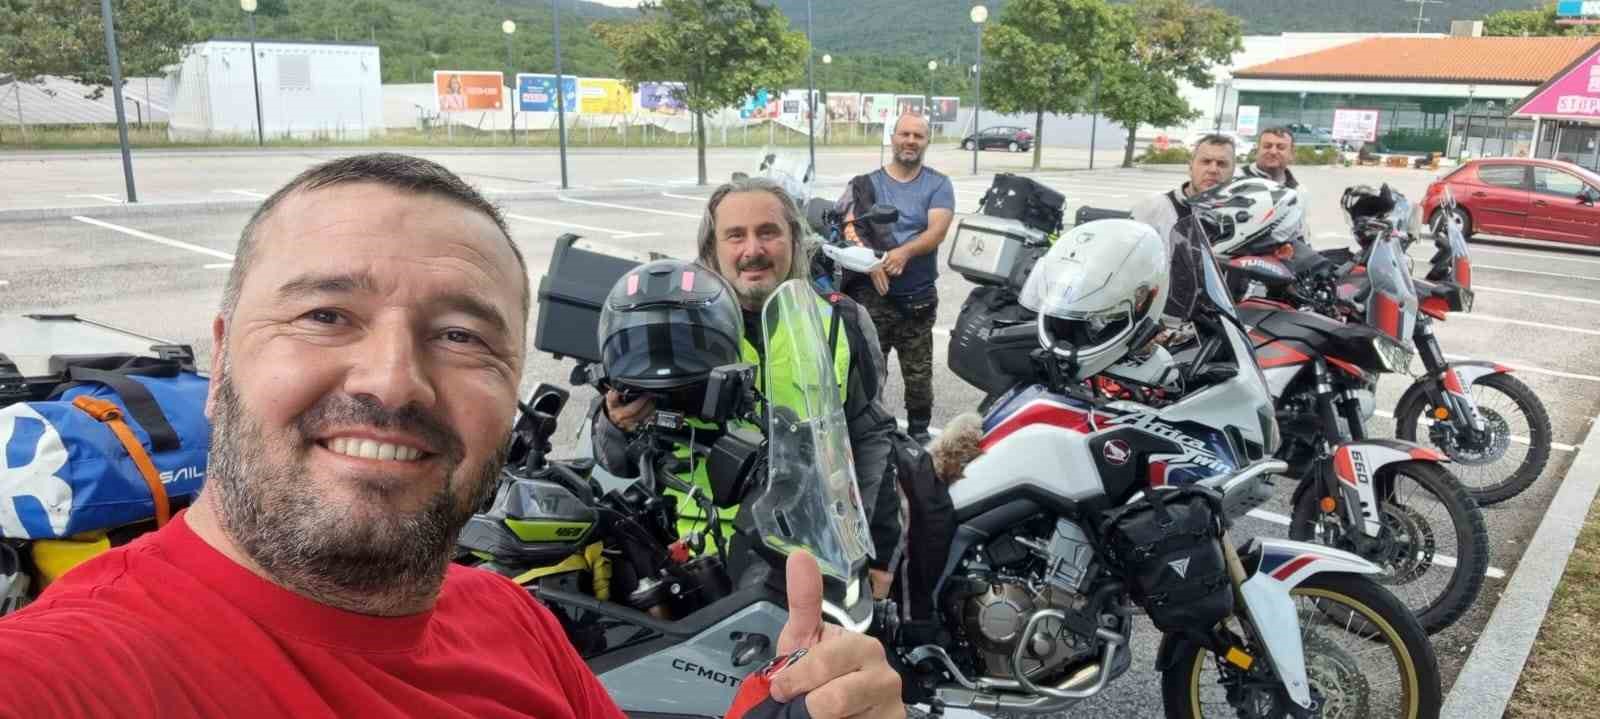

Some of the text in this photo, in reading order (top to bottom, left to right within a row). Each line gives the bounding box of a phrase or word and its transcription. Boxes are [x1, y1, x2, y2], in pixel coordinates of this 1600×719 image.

[1105, 411, 1206, 449] Africa
[1351, 450, 1369, 484] 660
[671, 658, 743, 687] CFMOT
